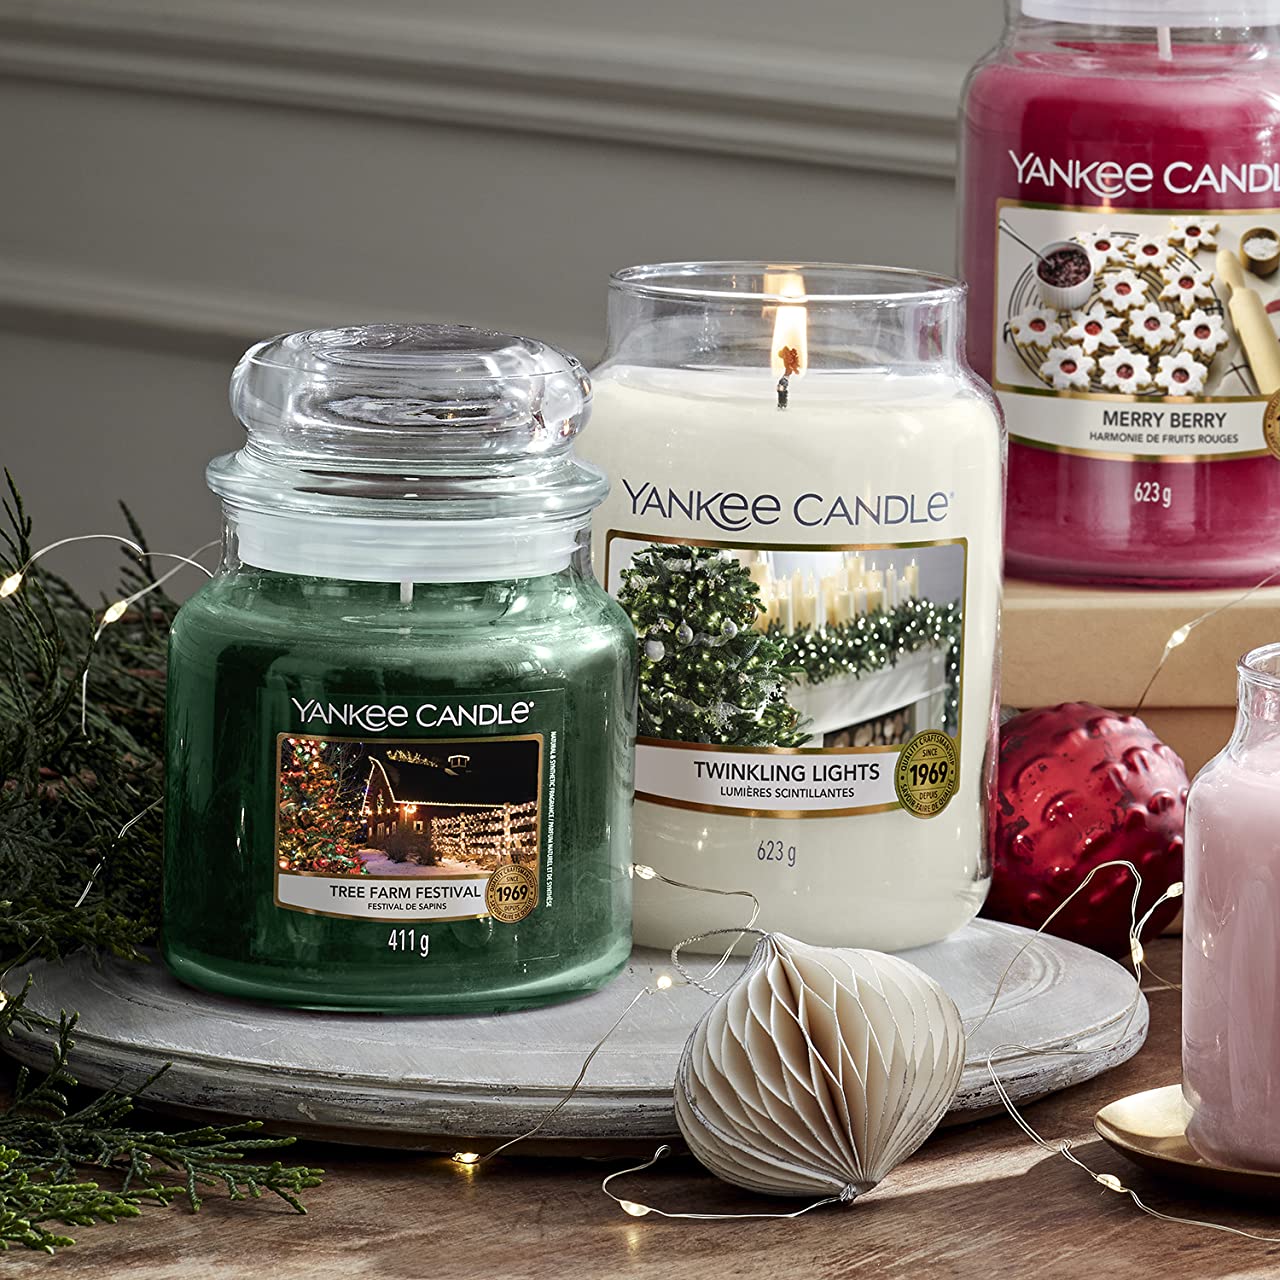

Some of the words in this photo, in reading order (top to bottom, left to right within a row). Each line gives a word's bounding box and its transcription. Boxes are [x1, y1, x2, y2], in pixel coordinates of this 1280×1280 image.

[1103, 410, 1164, 428] MERRY
[1170, 412, 1227, 428] BERRY
[1089, 431, 1143, 443] HARMONIE
[1147, 433, 1159, 443] DE
[1162, 434, 1195, 444] FRUITS
[1198, 433, 1239, 444] ROUGES
[901, 741, 919, 771] QUALITY
[919, 734, 955, 766] CRAFTSMANSHIP
[922, 748, 938, 757] SINCE
[693, 761, 806, 782] TWINKLING
[812, 763, 881, 781] LIGHTS
[910, 761, 948, 786] 1969
[720, 785, 772, 798] LUMIÈRES
[775, 787, 855, 798] SCINTILLANTES
[919, 791, 938, 800] DEPUIS
[932, 803, 939, 811] DE
[757, 840, 784, 861] 623
[787, 844, 796, 867] g
[330, 885, 366, 898] TREE
[370, 886, 411, 899] FARM
[415, 885, 481, 899] FESTIVAL
[496, 885, 528, 901] 1969
[388, 930, 415, 951] 411
[420, 935, 429, 957] g
